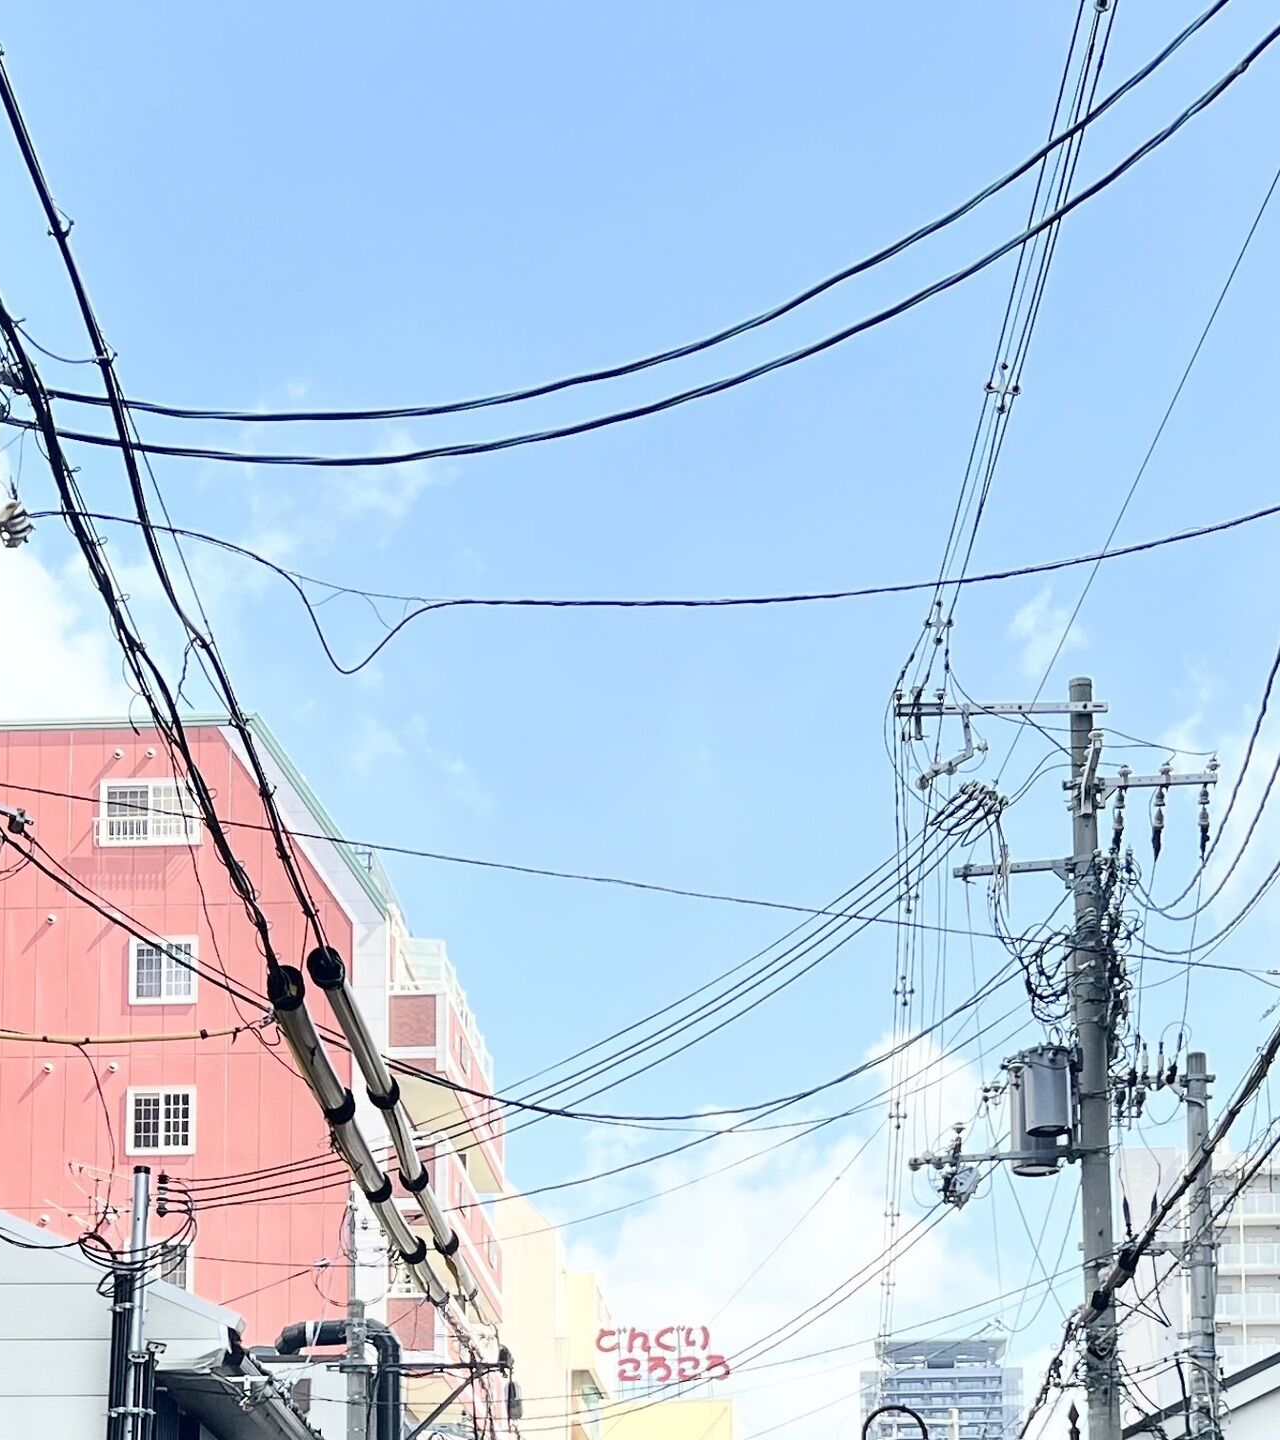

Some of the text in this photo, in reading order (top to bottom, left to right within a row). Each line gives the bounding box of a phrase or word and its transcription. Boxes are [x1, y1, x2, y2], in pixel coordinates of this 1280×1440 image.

[596, 1325, 710, 1353] どんぐり
[617, 1355, 730, 1382] ころころ
